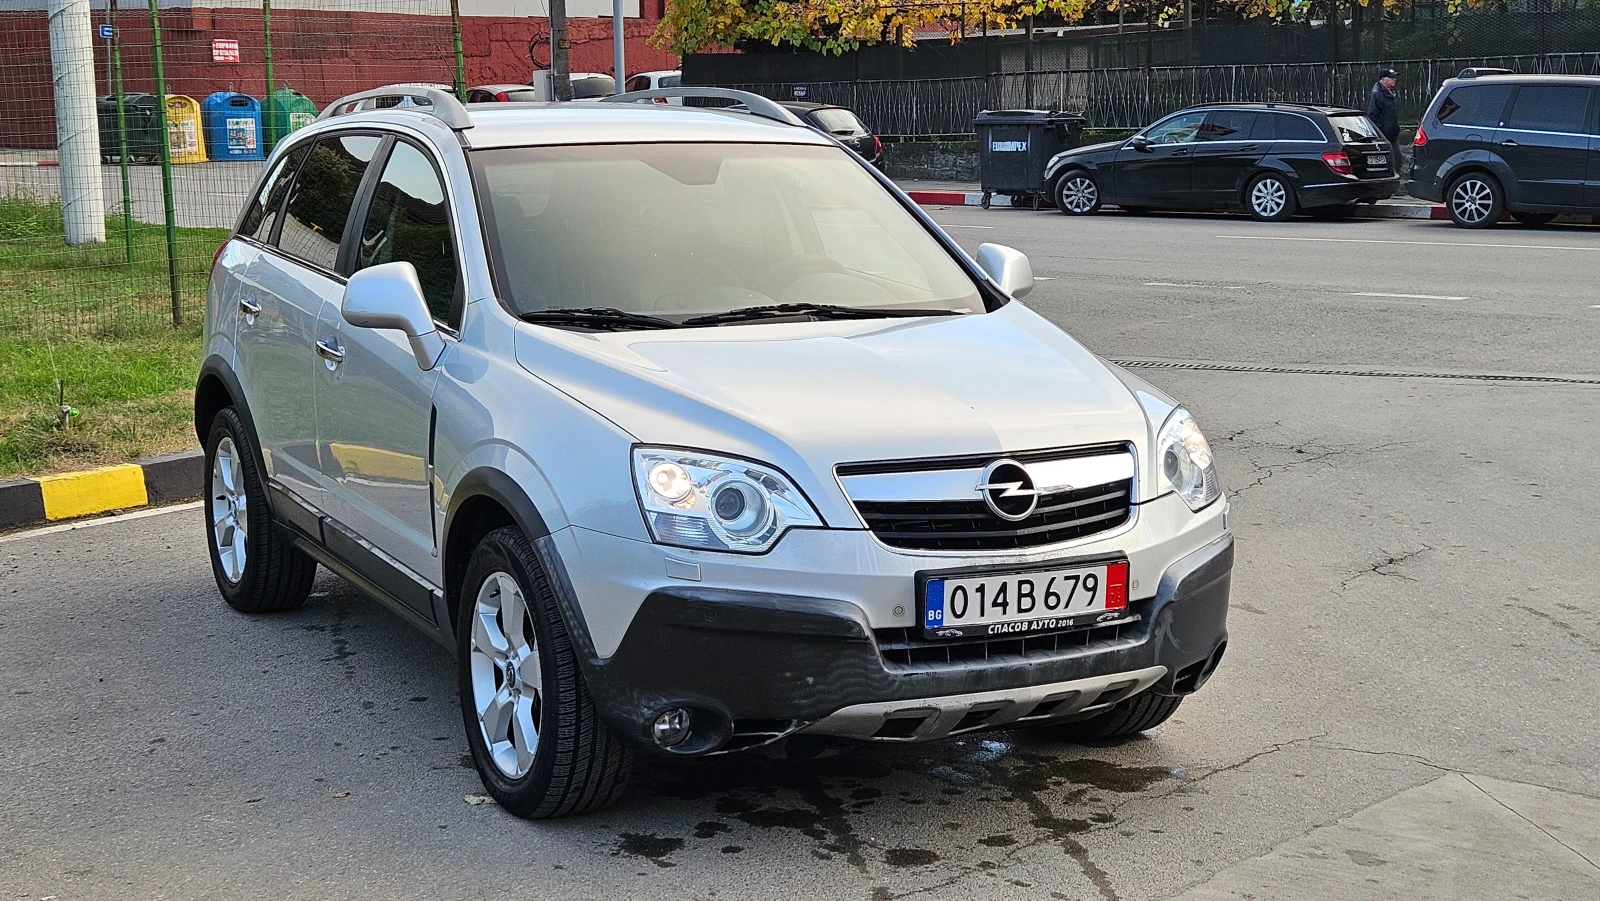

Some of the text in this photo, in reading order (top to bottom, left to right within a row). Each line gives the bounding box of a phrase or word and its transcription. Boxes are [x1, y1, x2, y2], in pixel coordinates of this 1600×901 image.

[949, 572, 1099, 619] 014B679
[928, 609, 942, 621] BG
[988, 618, 1074, 635] СПАСОВ АУТО 2016
